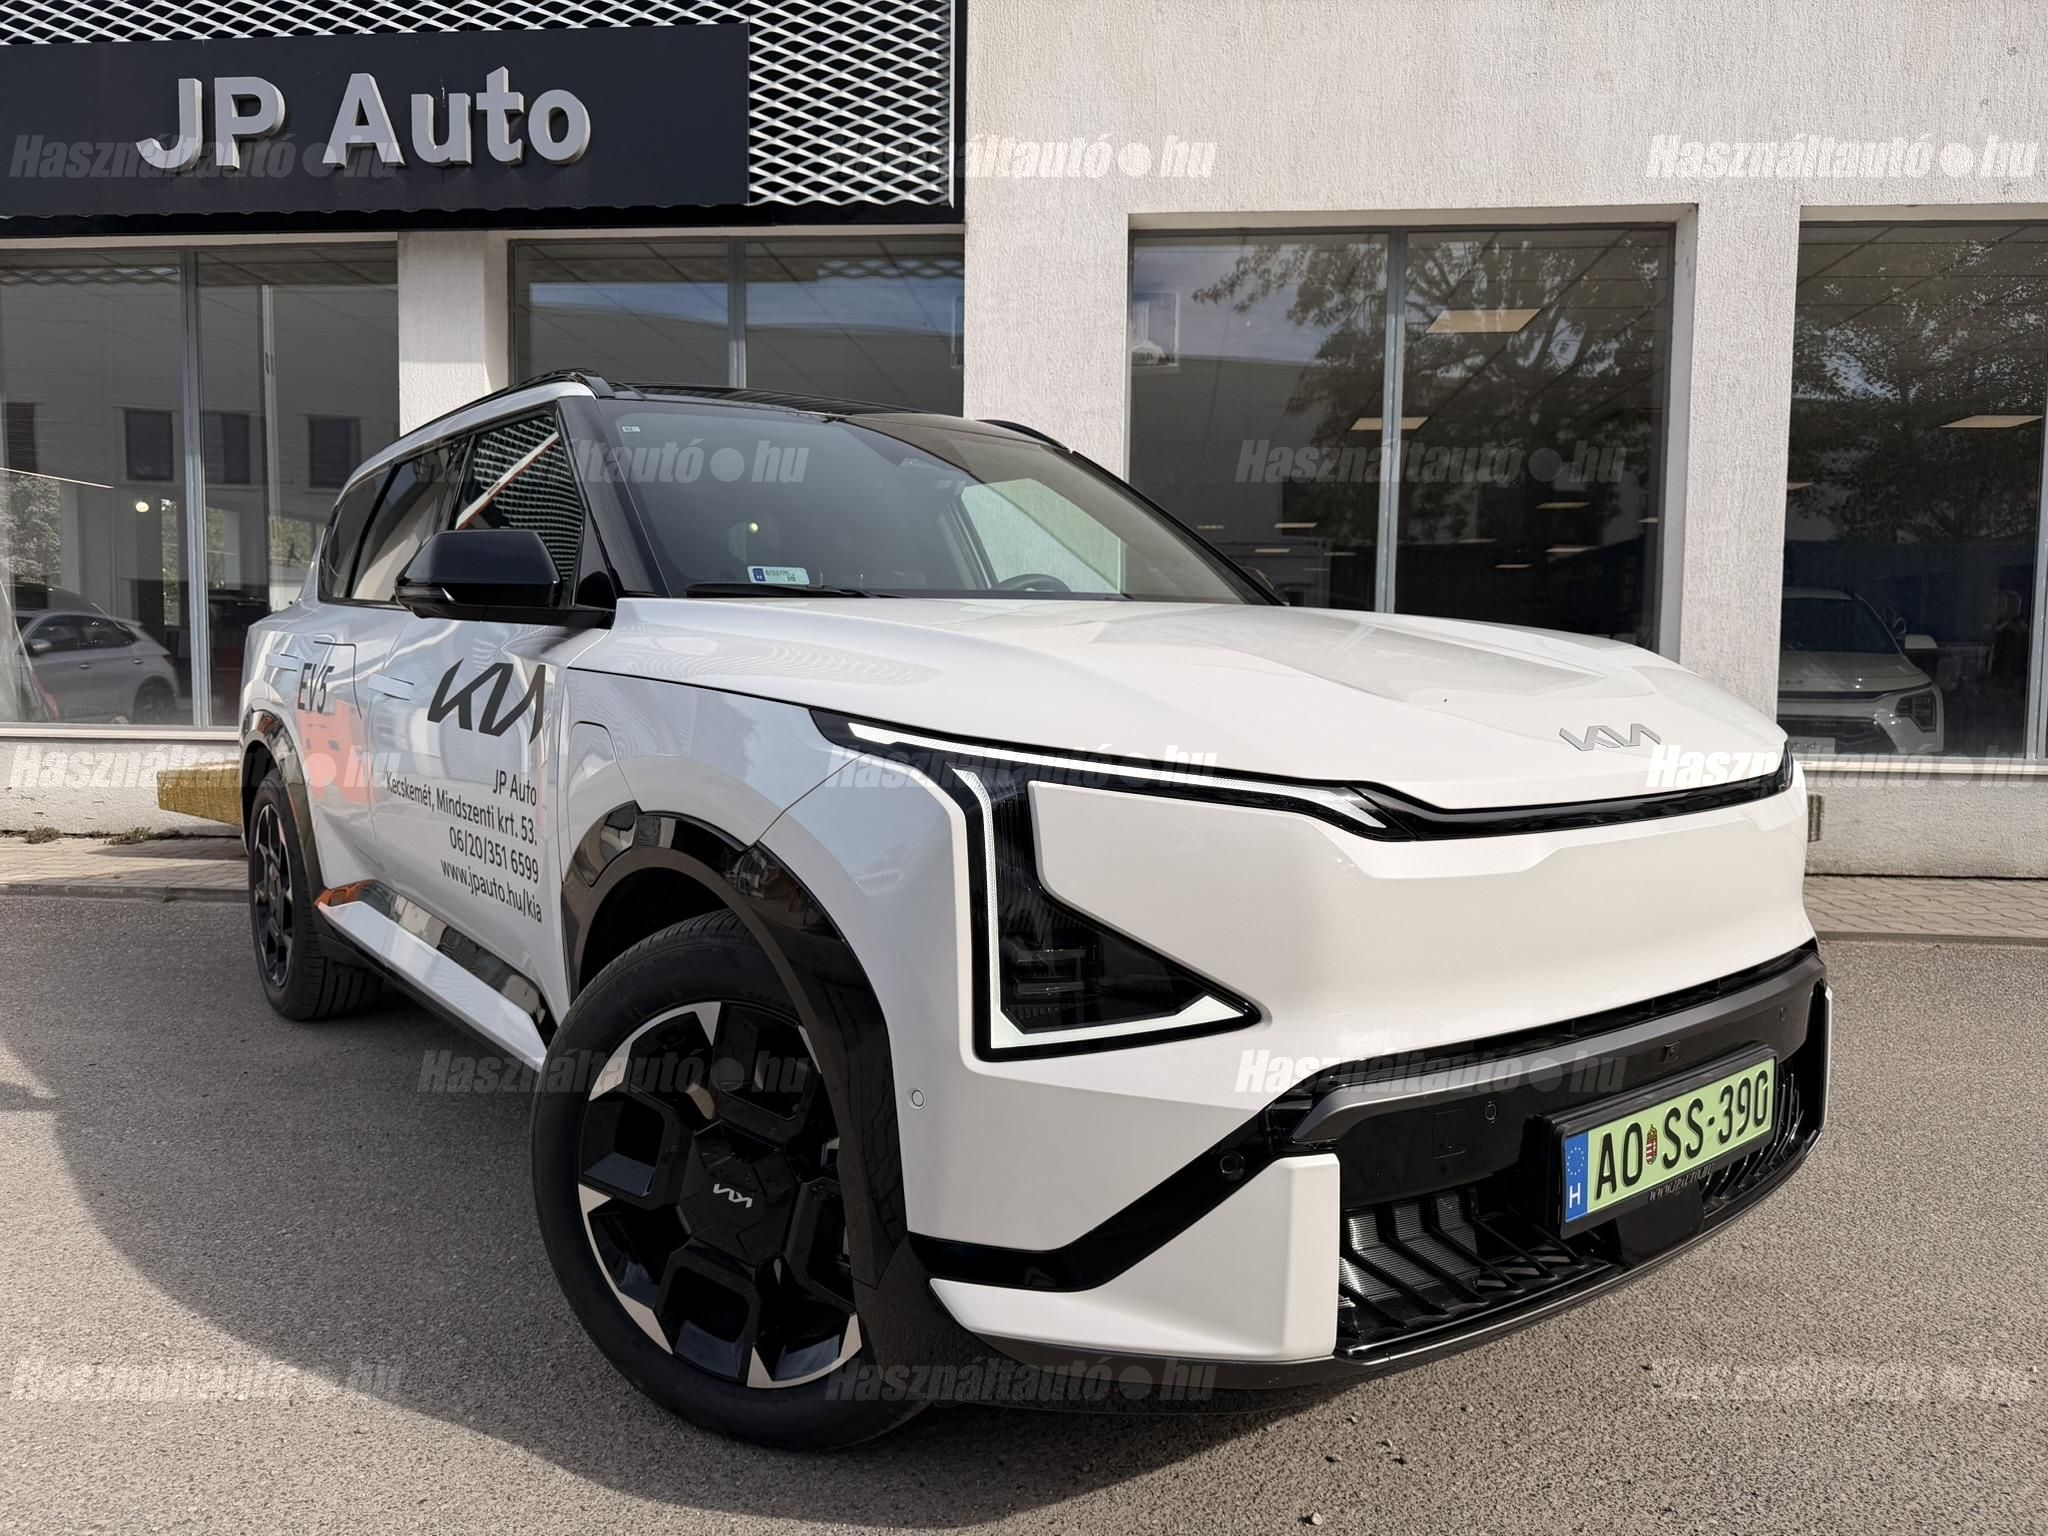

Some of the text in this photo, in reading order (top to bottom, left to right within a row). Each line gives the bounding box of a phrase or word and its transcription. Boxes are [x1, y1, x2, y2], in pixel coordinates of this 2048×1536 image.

[136, 66, 591, 170] JP Auto
[298, 663, 334, 714] EV5
[427, 658, 546, 744] KIA
[386, 771, 538, 846] Kecskemét, Mindszenti krt. 53.
[493, 769, 537, 806] JP Auto
[449, 826, 539, 884] 06/20/351 6599
[440, 859, 542, 924] www.jpauto.hu/kia
[1595, 1122, 1643, 1200] AO
[1569, 1182, 1581, 1208] H
